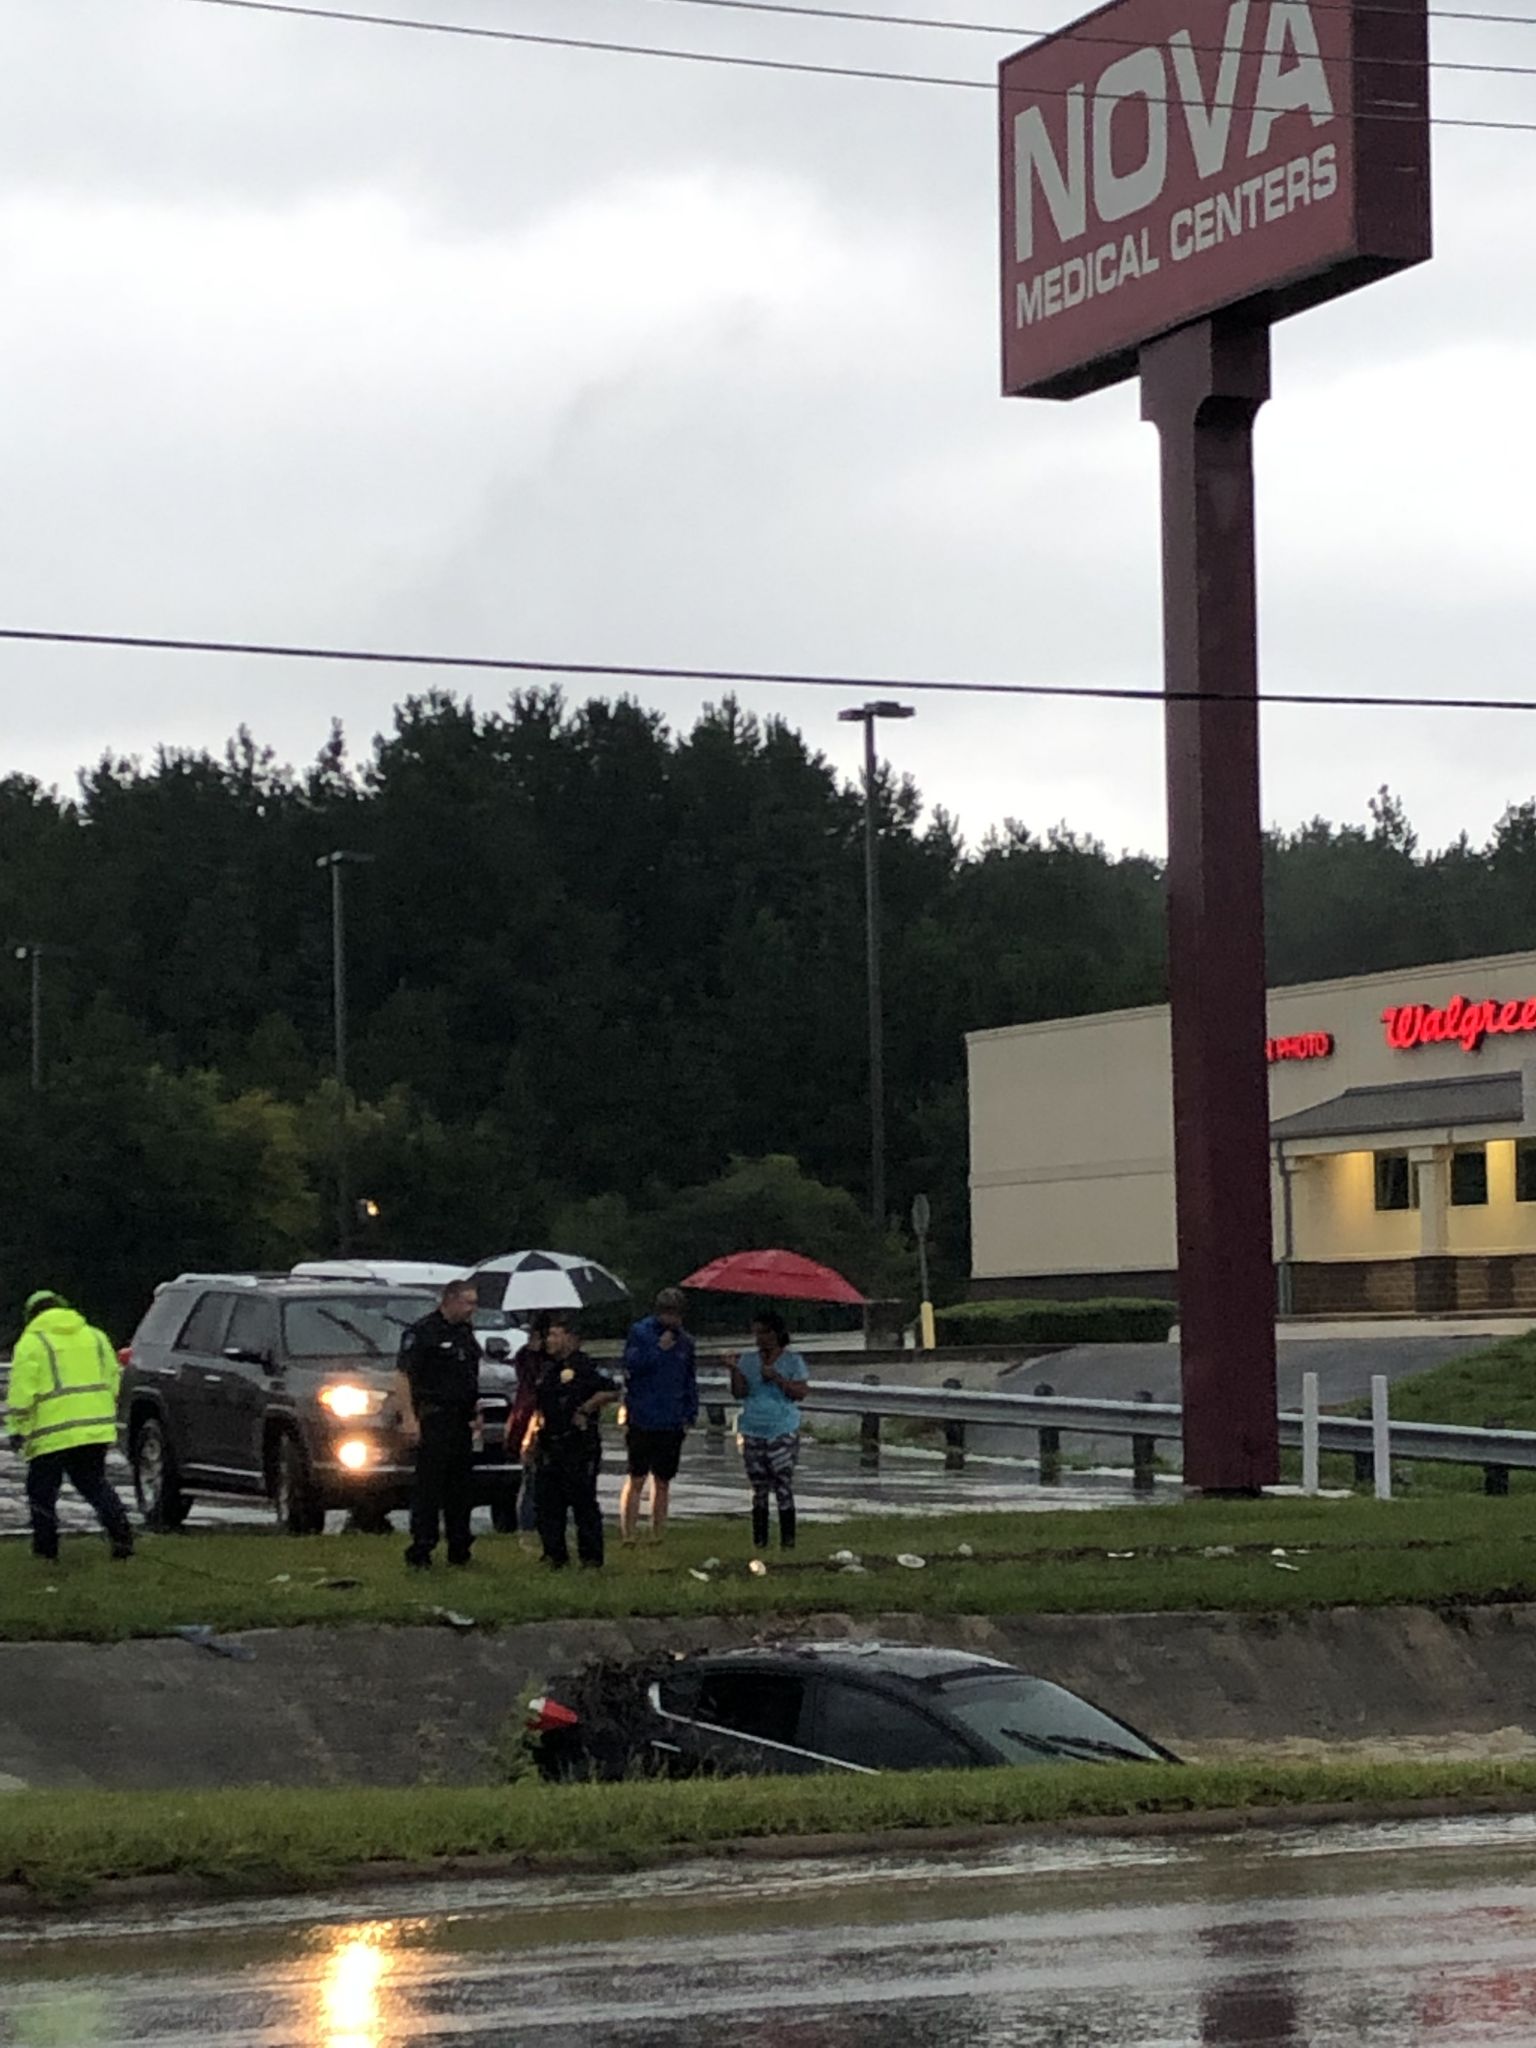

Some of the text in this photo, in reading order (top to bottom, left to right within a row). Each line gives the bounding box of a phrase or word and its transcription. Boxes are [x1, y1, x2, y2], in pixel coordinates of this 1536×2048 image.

[1014, 0, 1334, 263] NOVA
[1016, 143, 1336, 329] MEDICAL CENTERS
